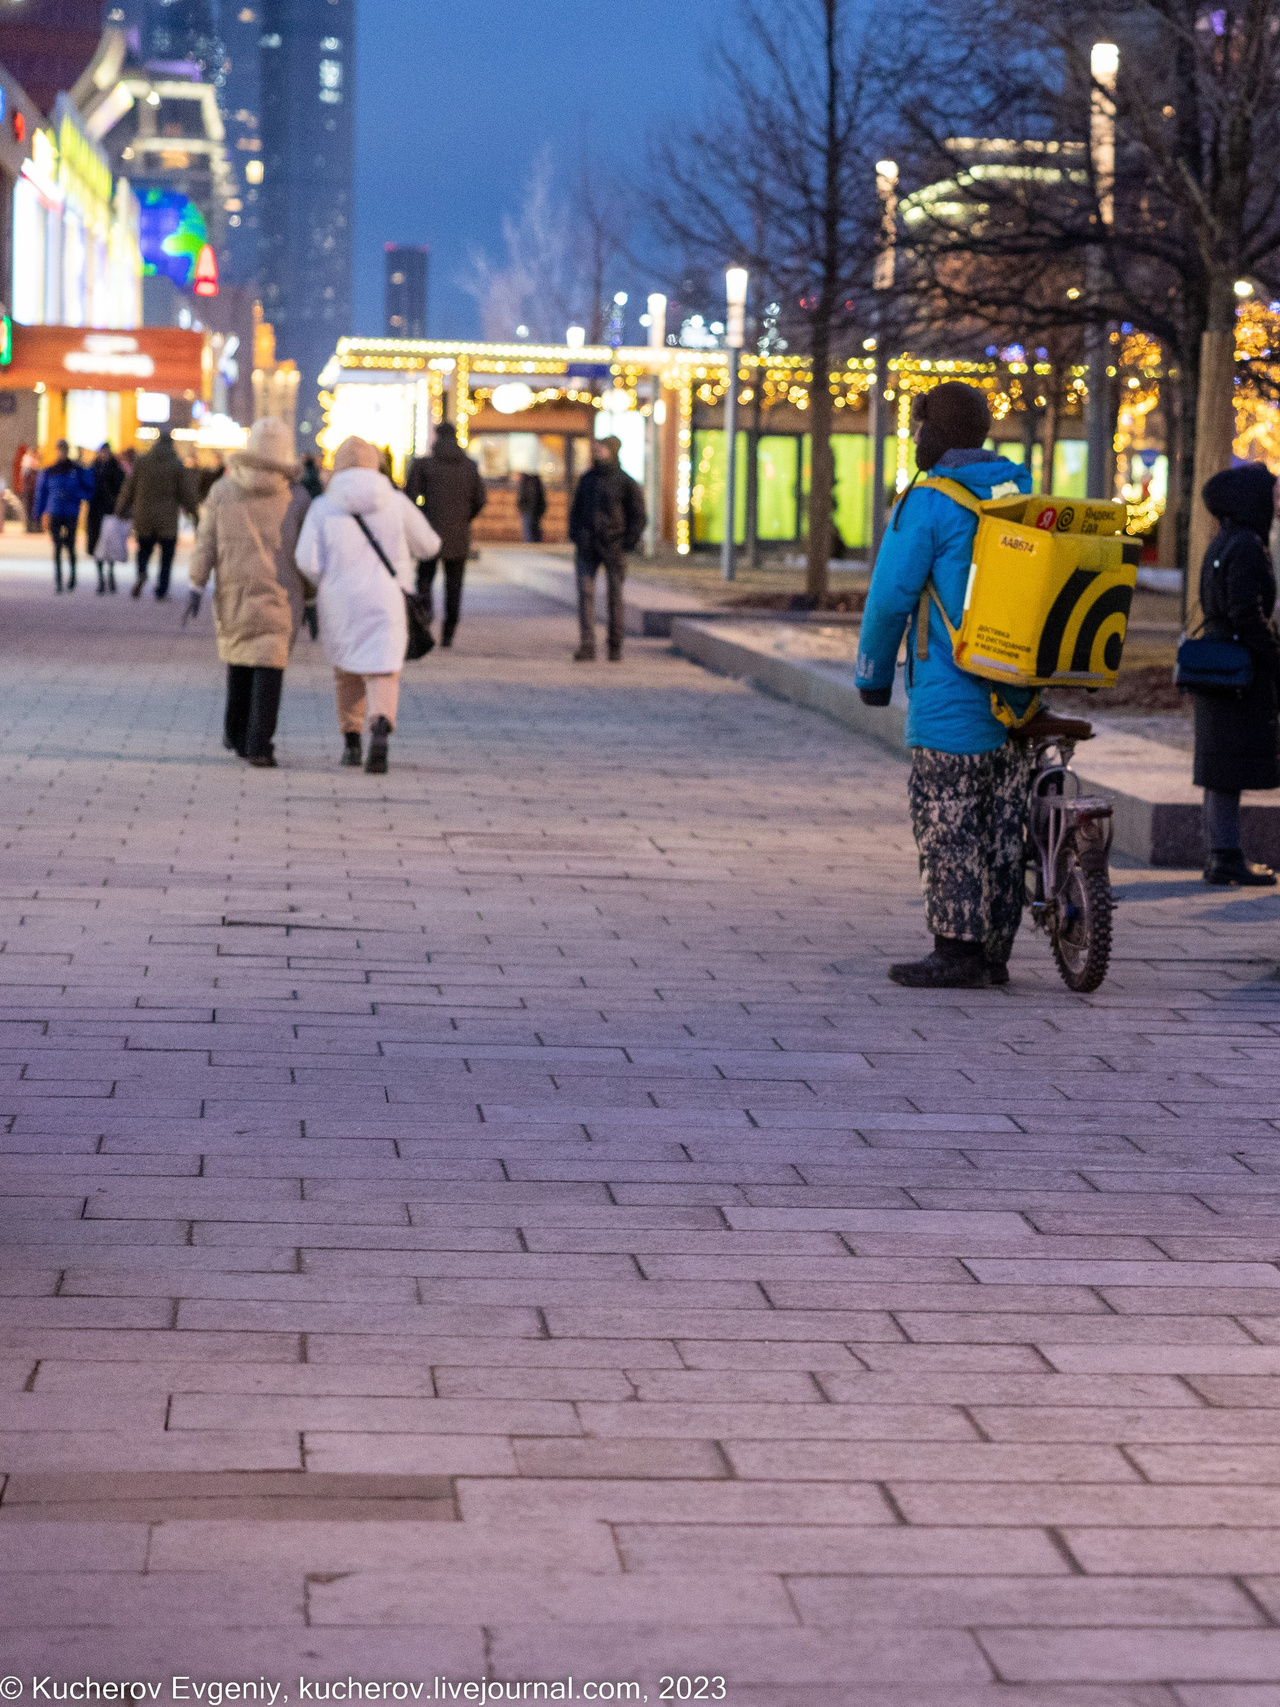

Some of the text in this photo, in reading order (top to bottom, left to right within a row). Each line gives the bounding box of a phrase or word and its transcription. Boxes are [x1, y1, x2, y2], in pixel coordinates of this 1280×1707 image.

[1039, 510, 1054, 529] Я
[1084, 507, 1116, 521] Яндекс
[1081, 520, 1098, 534] Еда
